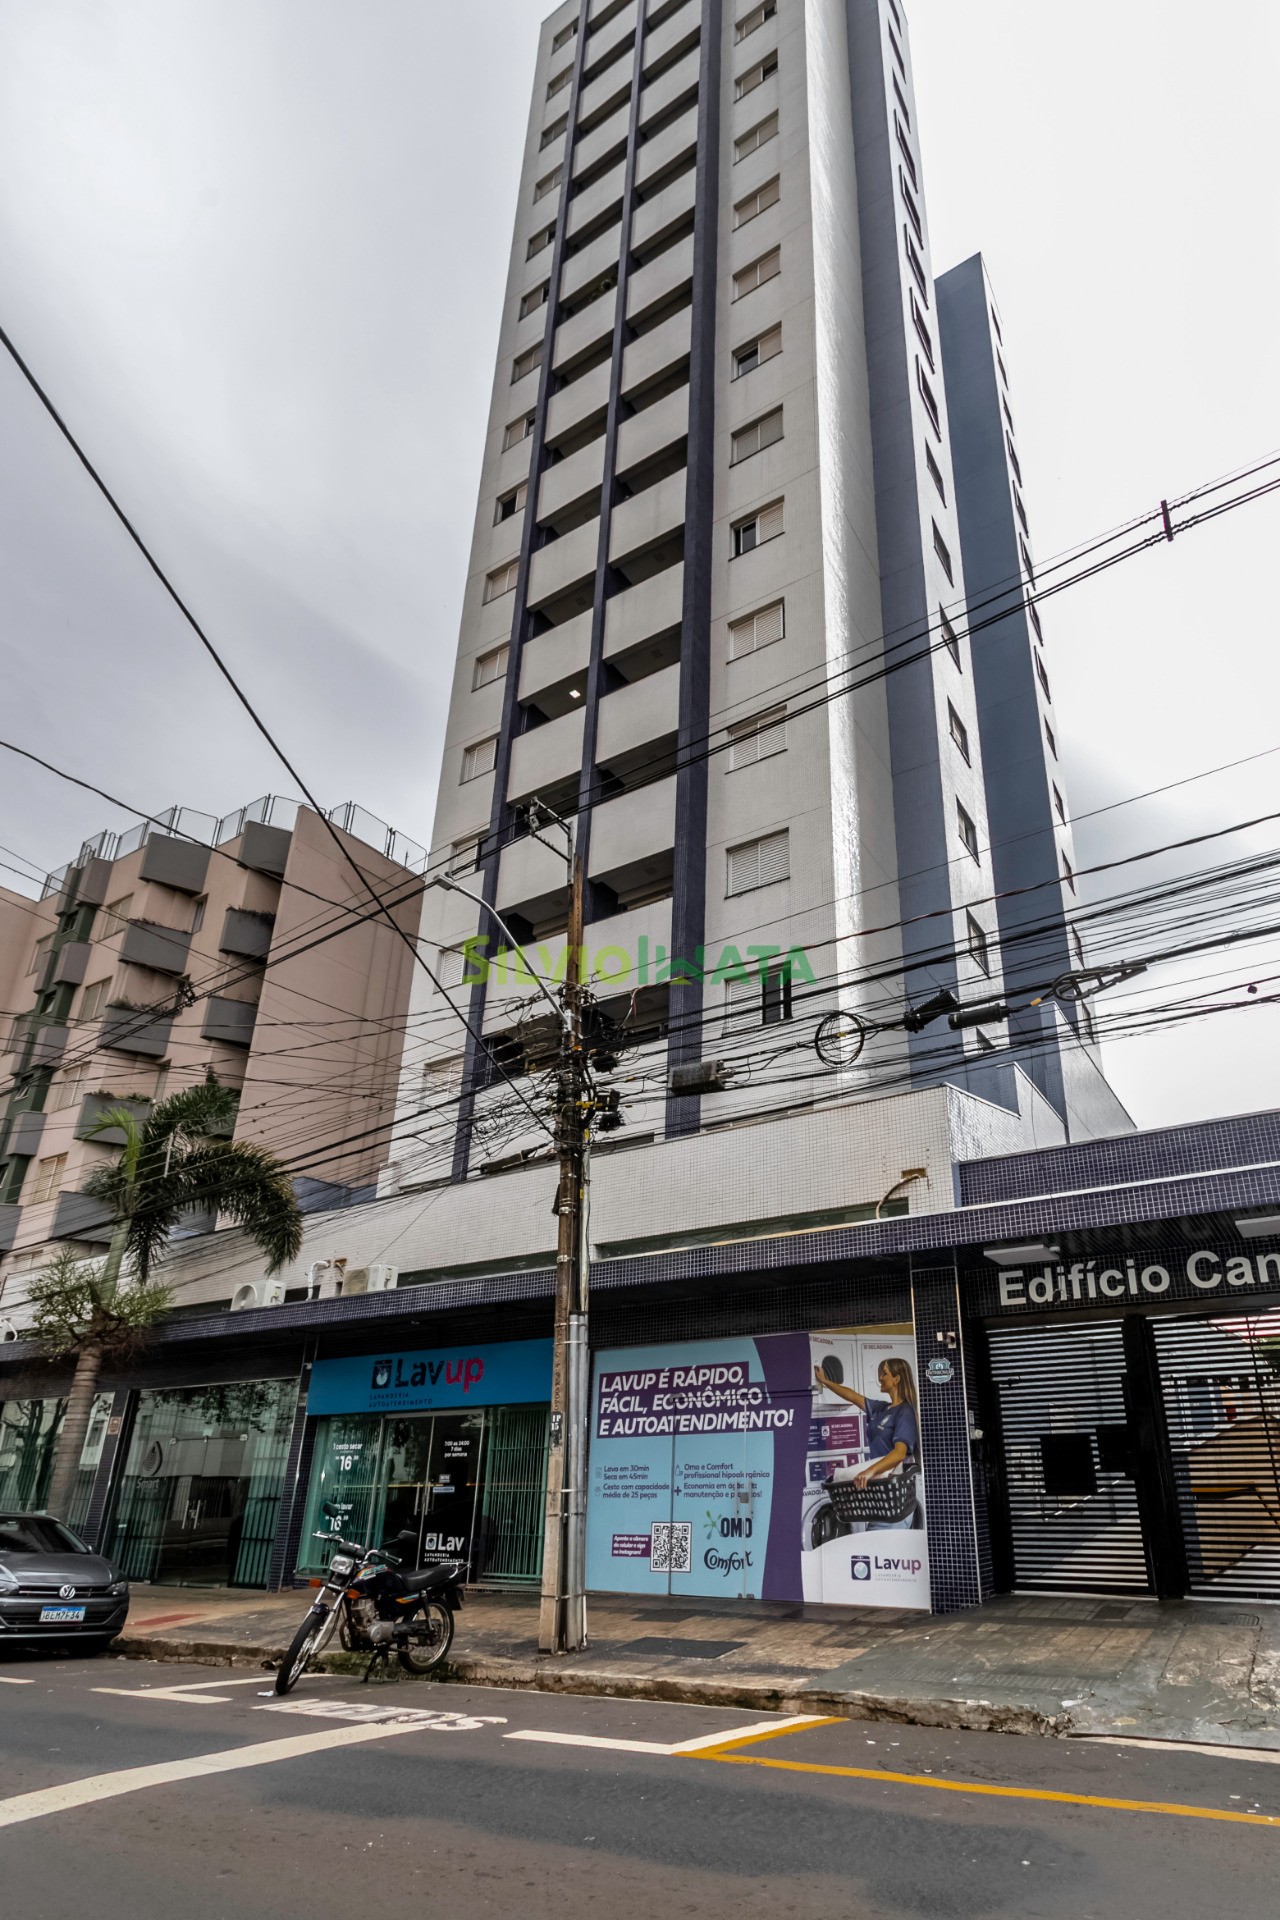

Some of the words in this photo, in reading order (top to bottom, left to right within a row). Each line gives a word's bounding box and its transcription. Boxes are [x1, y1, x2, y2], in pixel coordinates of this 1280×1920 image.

[998, 1259, 1170, 1306] Edifício
[395, 1358, 484, 1394] Lavup
[601, 1373, 656, 1393] LAVUP
[659, 1367, 670, 1389] É
[672, 1365, 744, 1388] RÁPIDO,
[600, 1392, 648, 1414] FÁCIL,
[652, 1385, 763, 1412] ECONÔMICO
[600, 1419, 611, 1436] E
[611, 1408, 794, 1436] AUTOATENDIMENTO!
[630, 1464, 650, 1472] 30min
[706, 1462, 734, 1470] Comfort
[629, 1472, 649, 1480] 45min
[683, 1470, 720, 1480] profissional
[136, 1478, 160, 1489] Smart
[634, 1482, 670, 1491] capacidade
[640, 1492, 658, 1500] peças
[683, 1490, 724, 1500] manutenção
[721, 1517, 753, 1538] OMO
[704, 1547, 753, 1578] Comfort
[874, 1555, 922, 1575] Lavup
